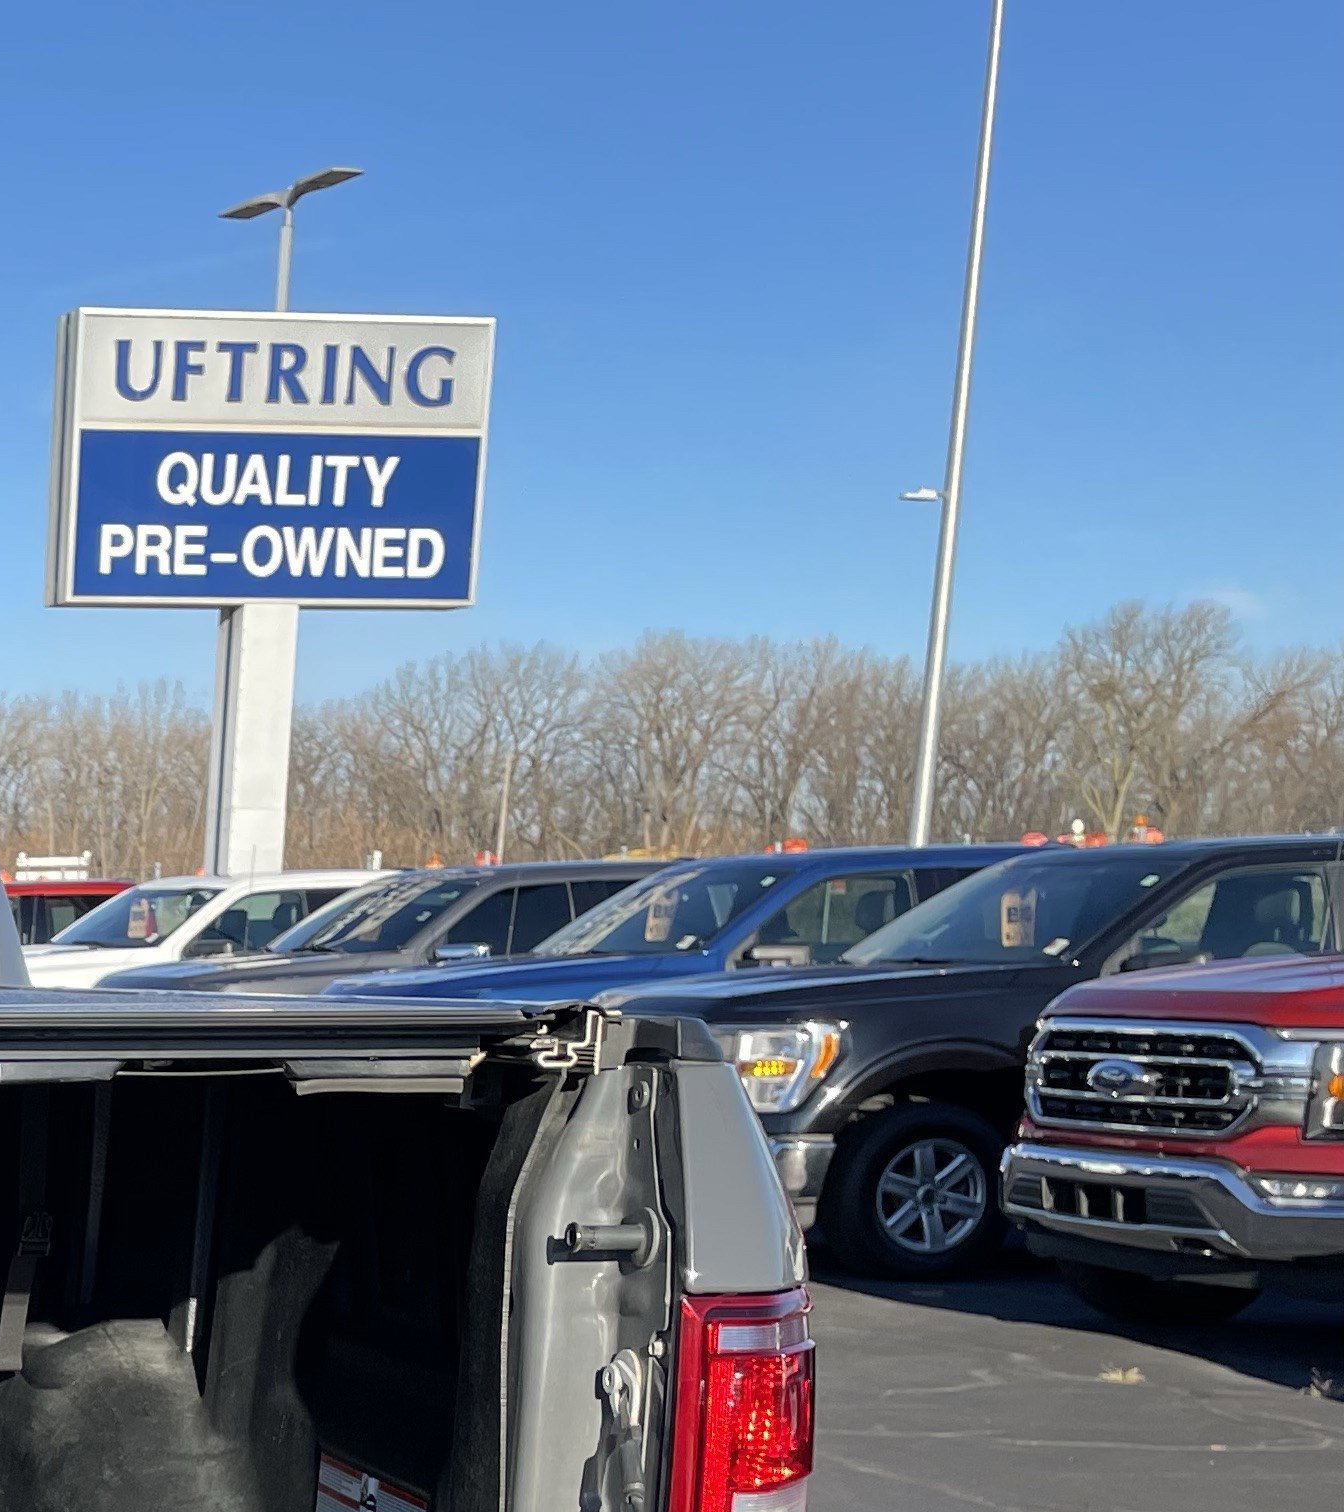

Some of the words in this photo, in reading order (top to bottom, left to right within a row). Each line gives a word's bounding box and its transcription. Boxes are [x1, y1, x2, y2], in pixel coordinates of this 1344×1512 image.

[113, 338, 456, 408] UFTRING
[156, 451, 402, 508] QUALITY
[98, 523, 446, 580] PRE-OWNED
